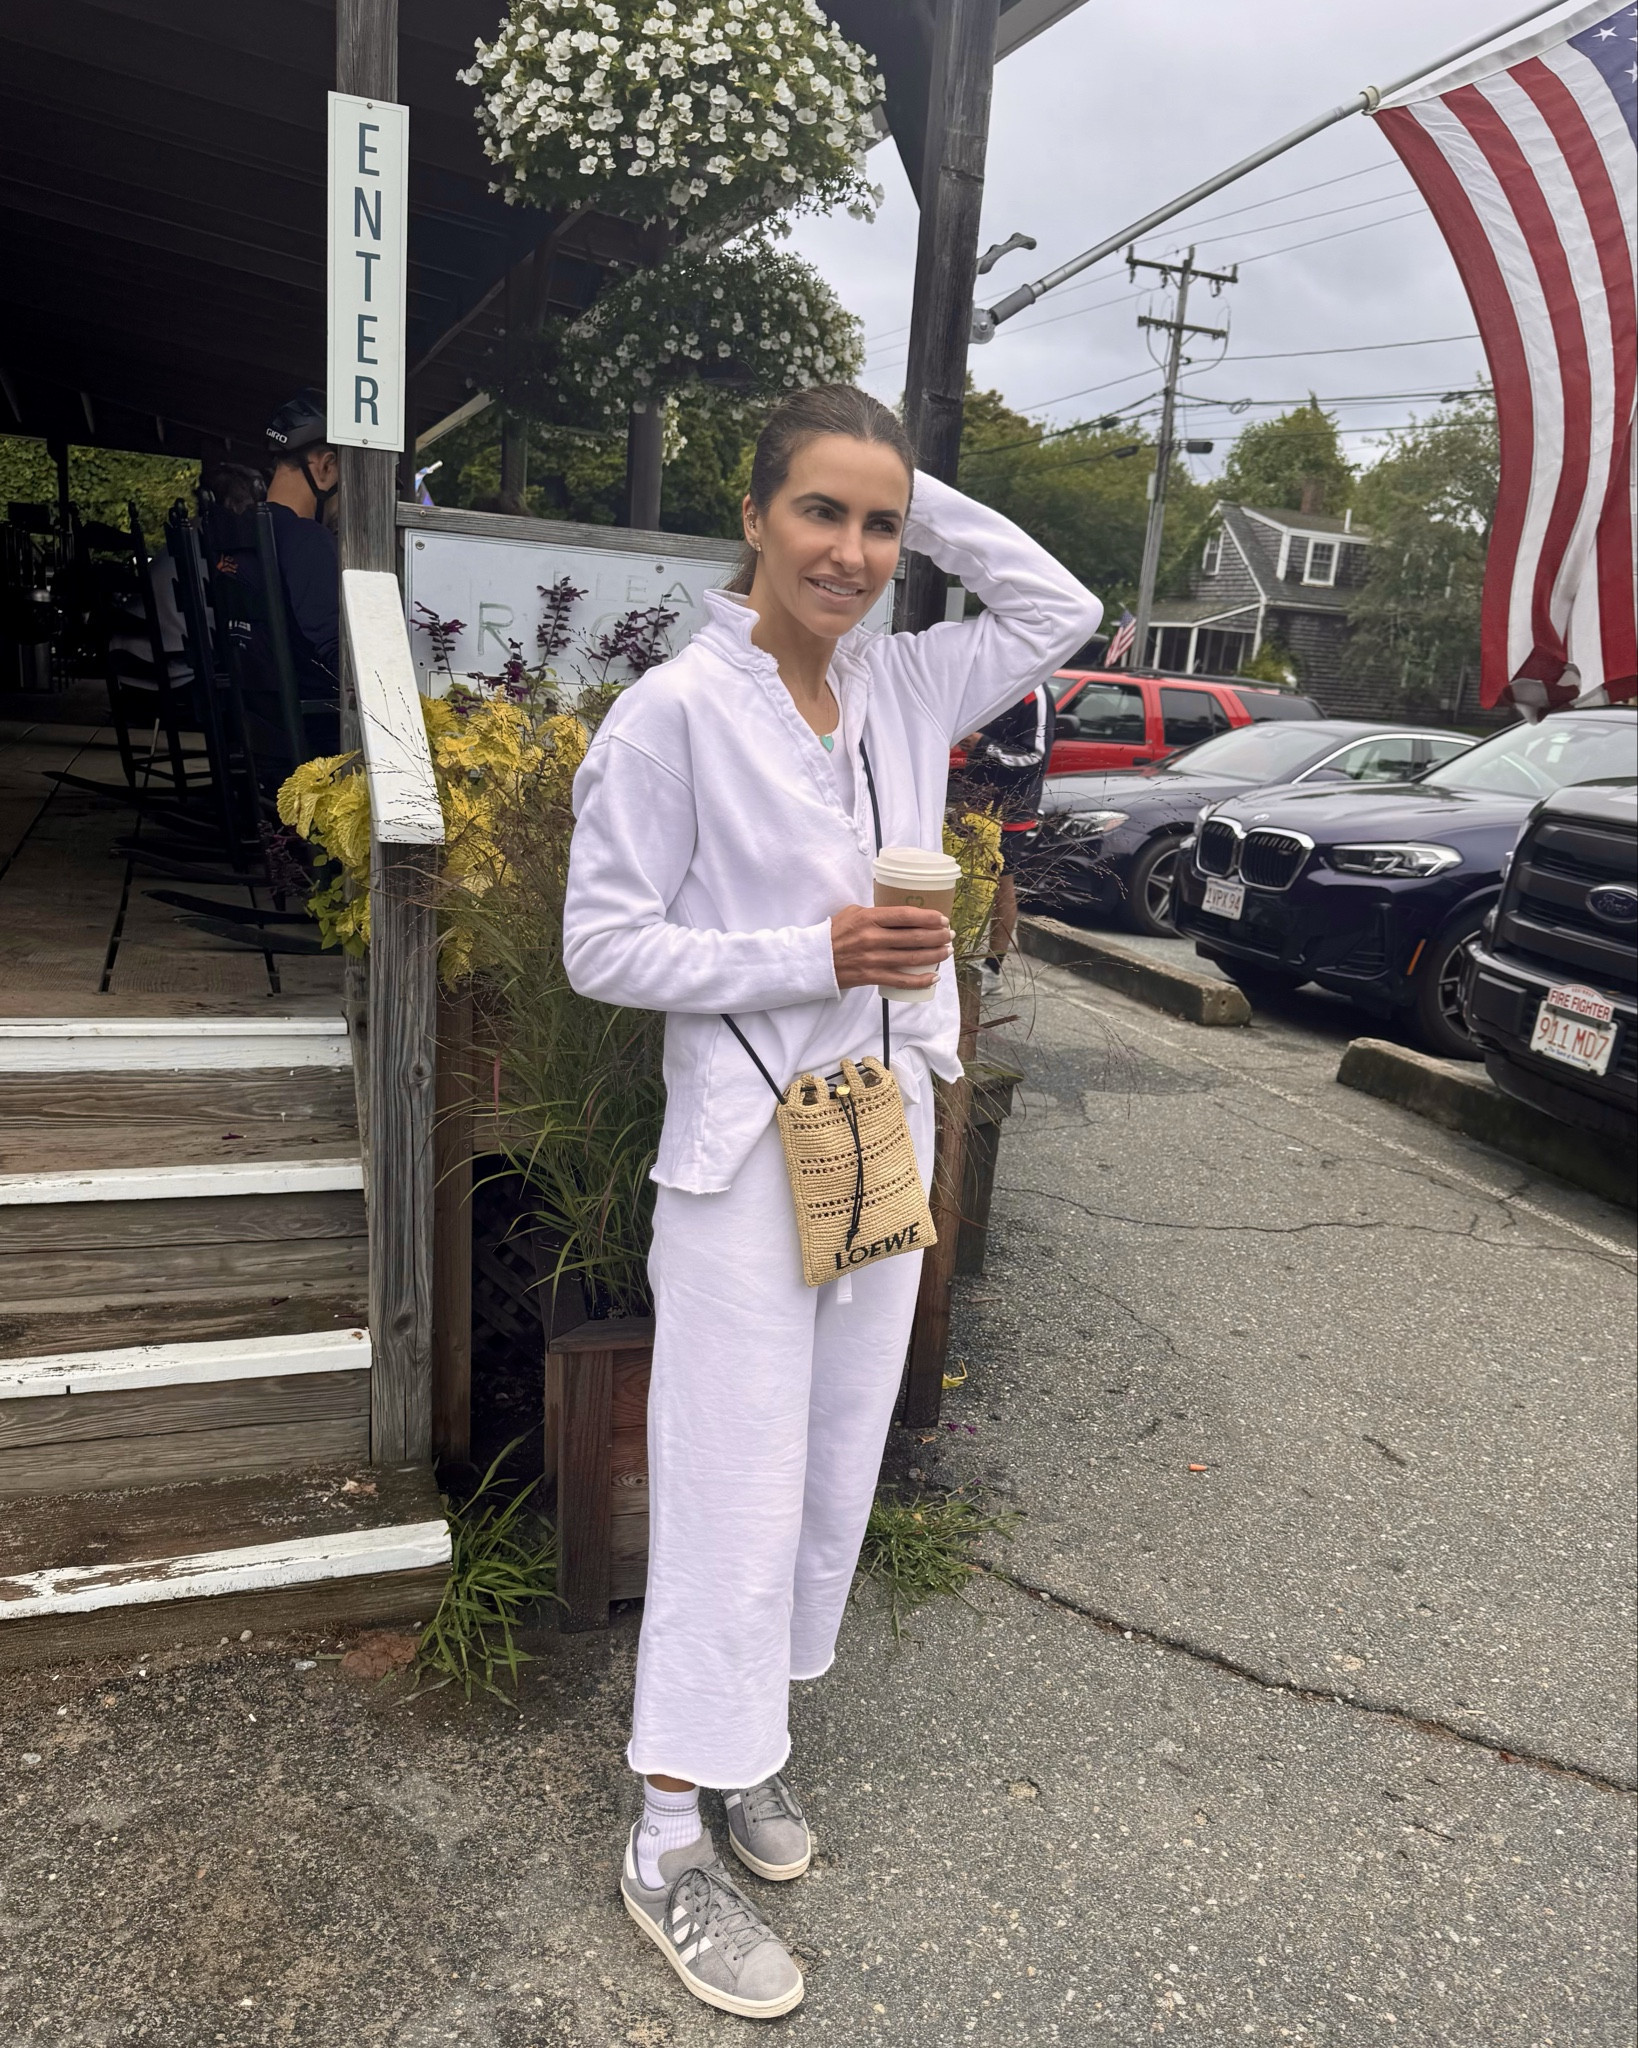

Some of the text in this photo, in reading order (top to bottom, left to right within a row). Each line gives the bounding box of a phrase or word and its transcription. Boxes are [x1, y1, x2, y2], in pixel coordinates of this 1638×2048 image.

[354, 122, 382, 426] ENTER
[266, 427, 288, 444] GIRO
[1549, 990, 1571, 1008] FIRE
[1570, 996, 1611, 1021] FIGHTER
[1537, 1017, 1610, 1061] 911 MD7
[834, 1221, 921, 1271] LOEWE
[641, 1816, 661, 1837] lo
